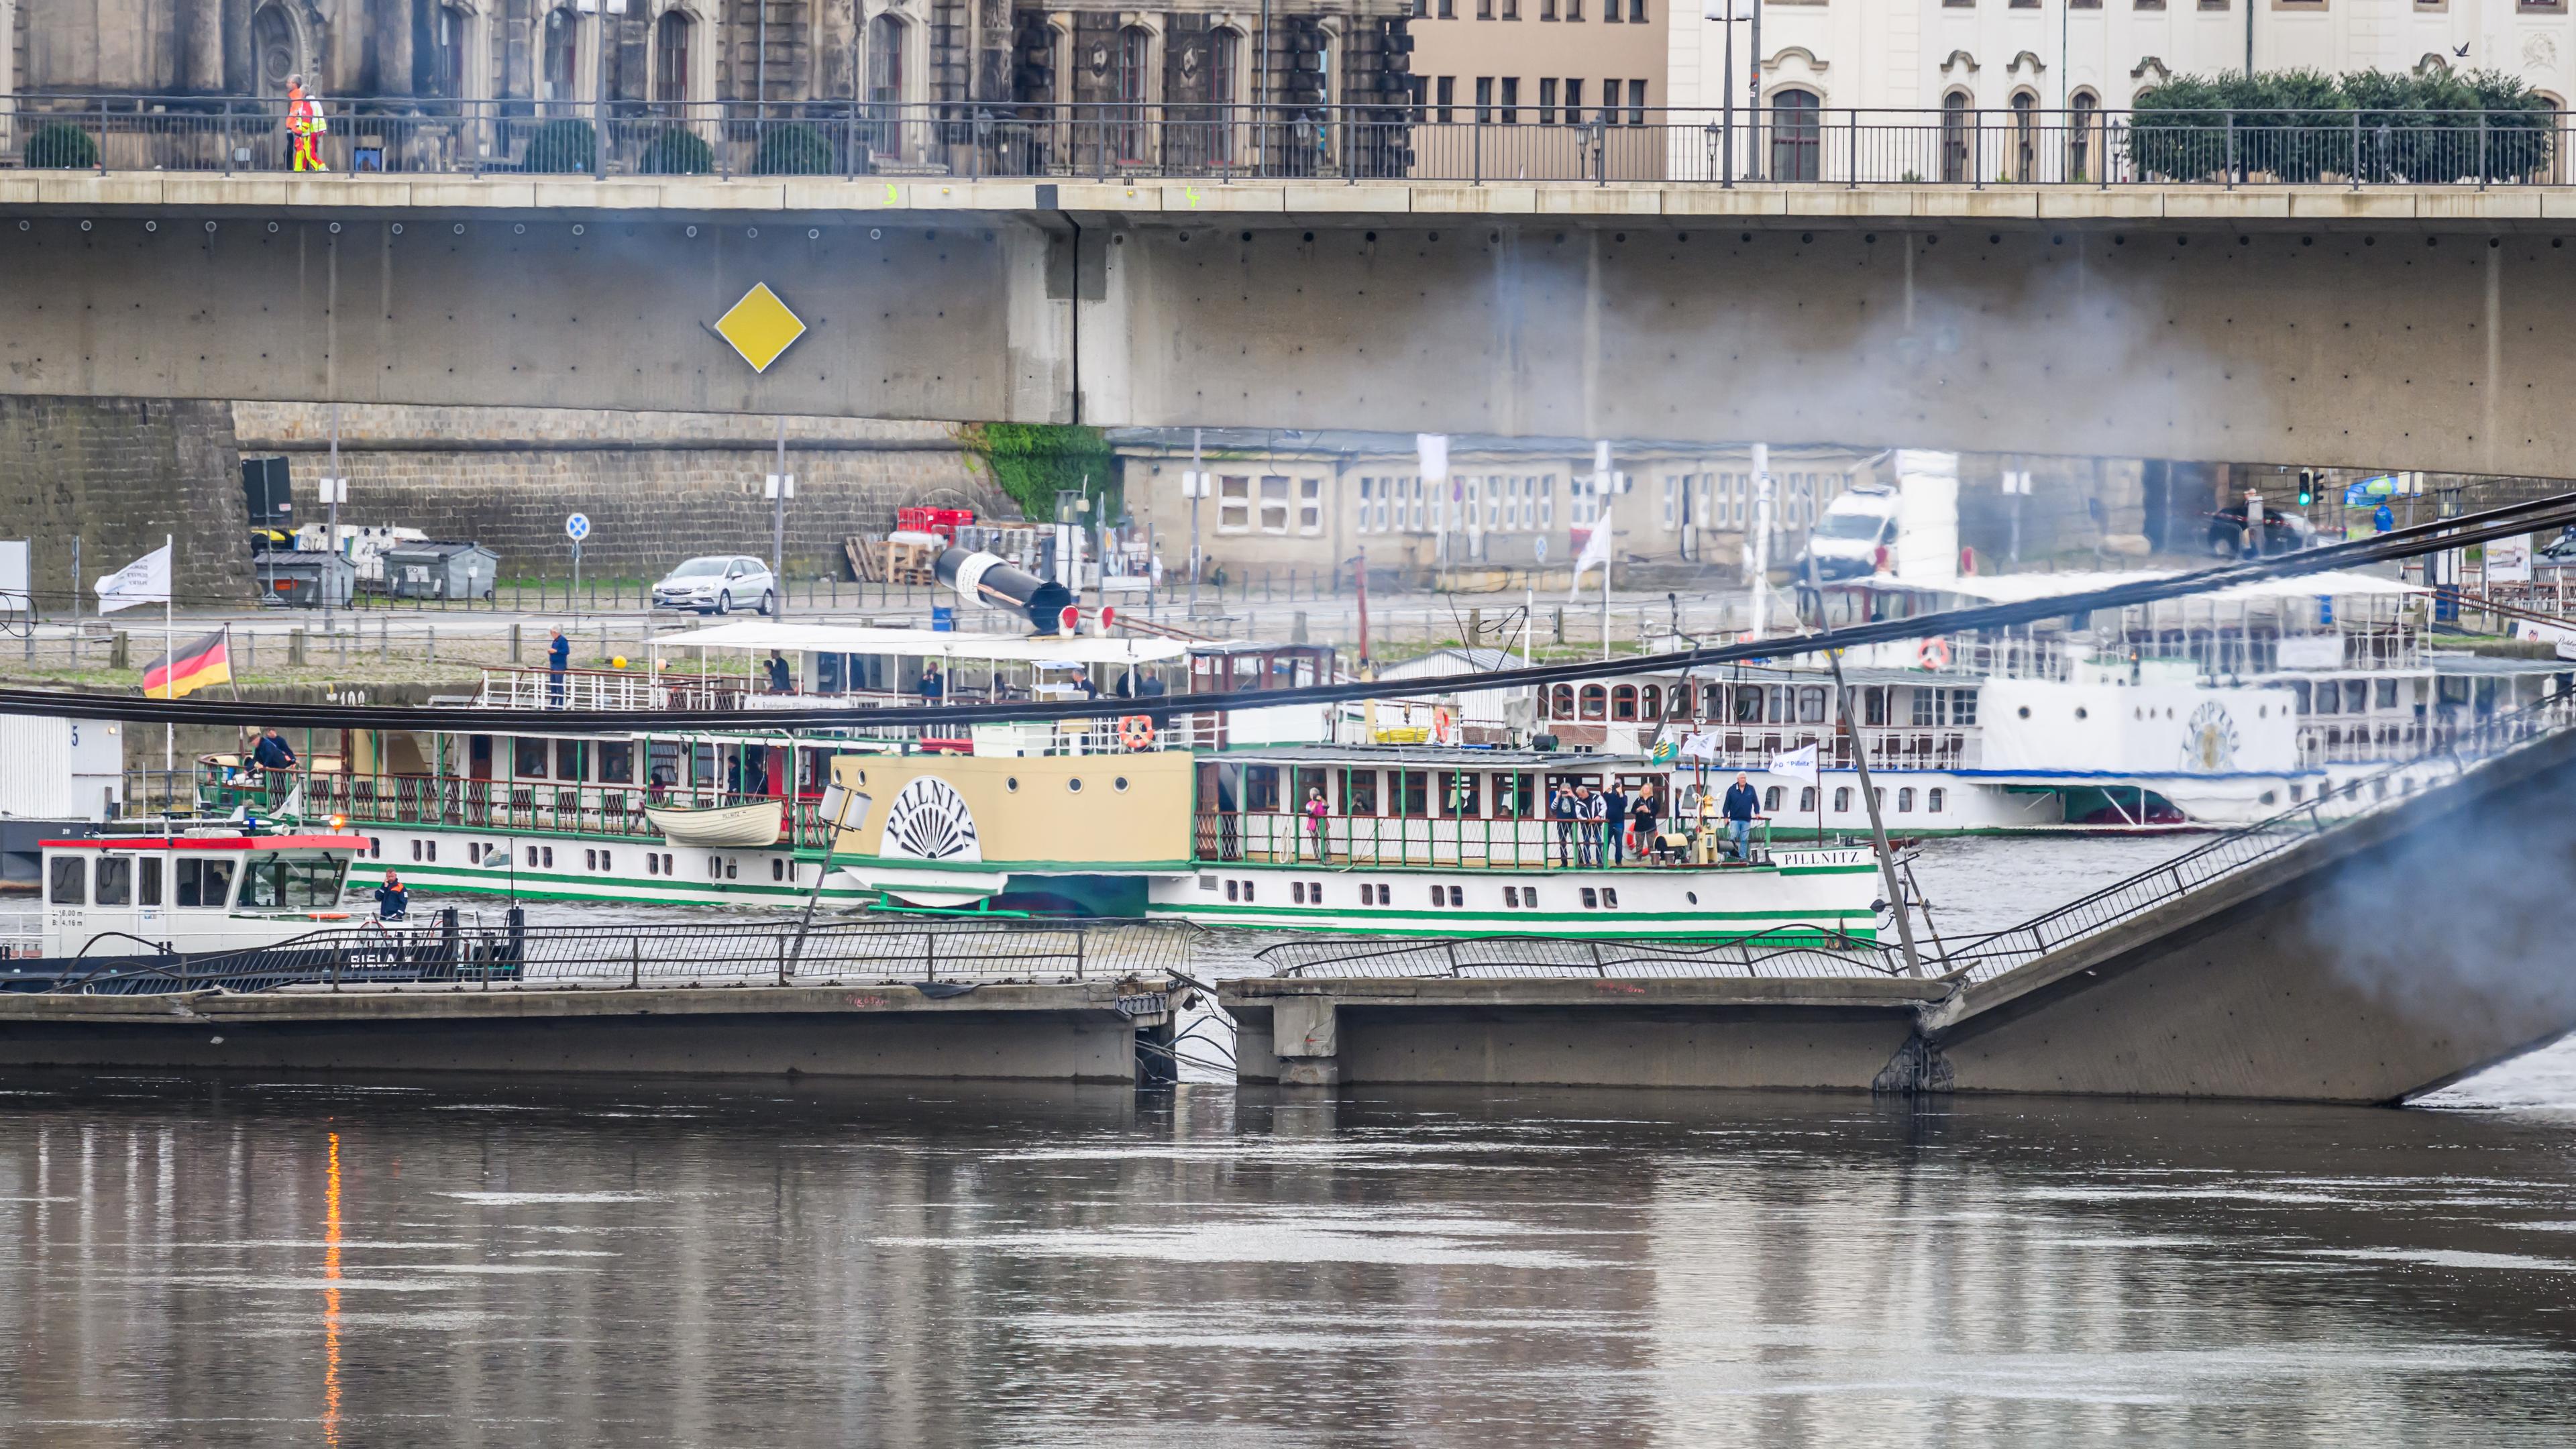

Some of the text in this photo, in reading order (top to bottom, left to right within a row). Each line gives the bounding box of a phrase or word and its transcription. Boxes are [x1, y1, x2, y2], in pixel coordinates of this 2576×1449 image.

[72, 725, 78, 747] 5
[887, 779, 976, 848] PILLNITZ
[1784, 851, 1860, 865] PILLNITZ
